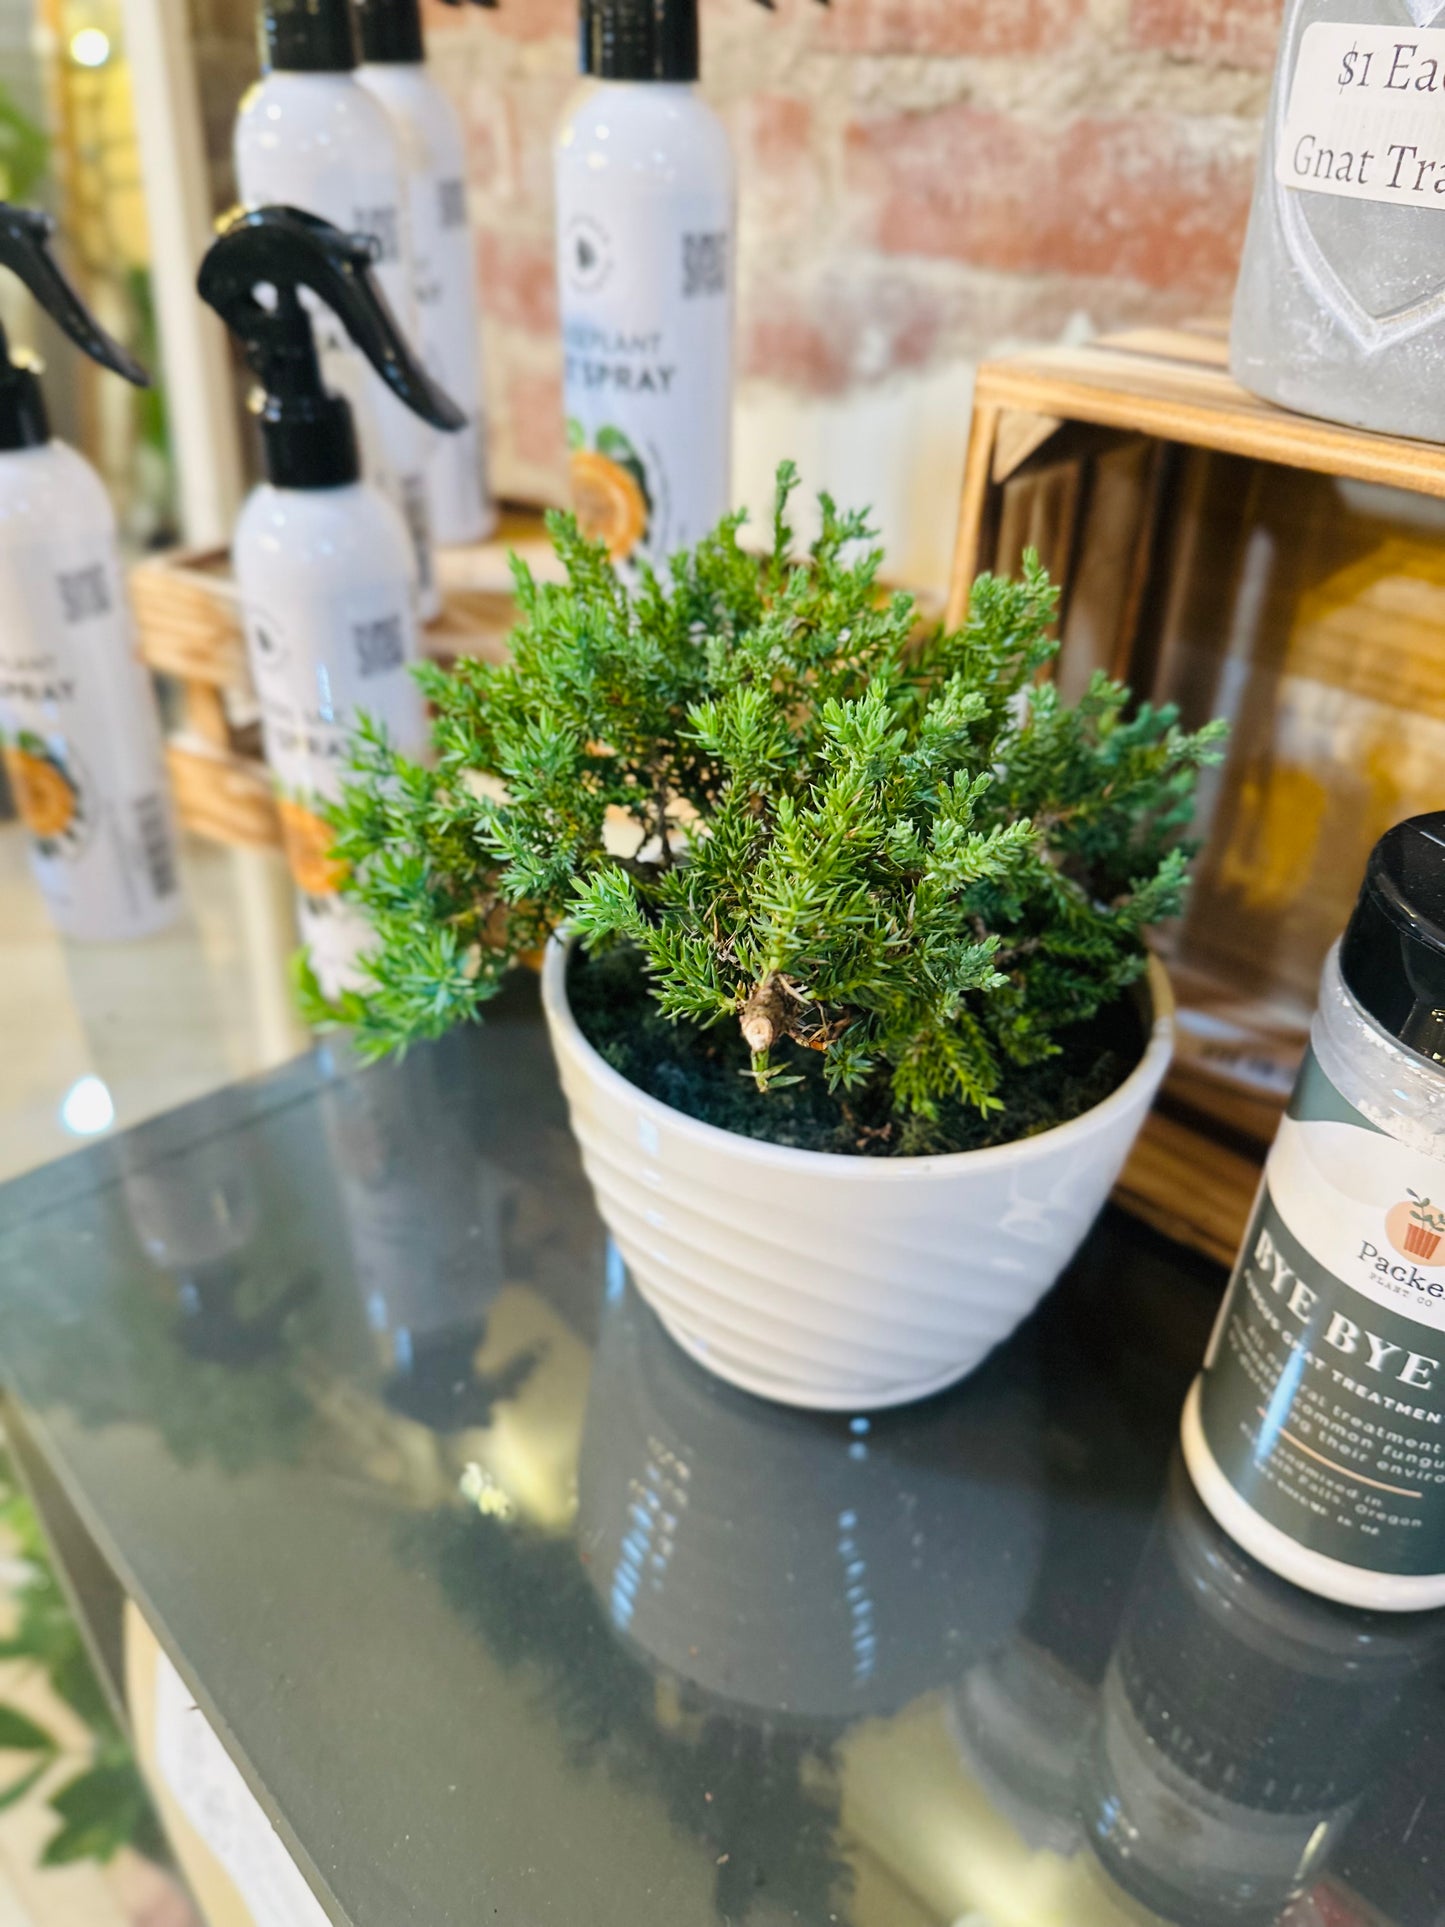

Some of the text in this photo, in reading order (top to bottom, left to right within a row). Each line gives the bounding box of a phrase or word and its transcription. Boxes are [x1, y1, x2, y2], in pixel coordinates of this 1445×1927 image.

[1337, 41, 1445, 95] $1 Ea
[1293, 134, 1375, 185] Gnat
[1357, 1239, 1445, 1300] Packe
[1368, 1271, 1411, 1298] PLANT
[1254, 1227, 1320, 1325] BYE
[1322, 1310, 1441, 1391] BYE
[1331, 1368, 1445, 1424] TREATMEN
[1318, 1430, 1369, 1463] their
[1332, 1404, 1443, 1454] treatment
[1354, 1502, 1423, 1528] Oregon
